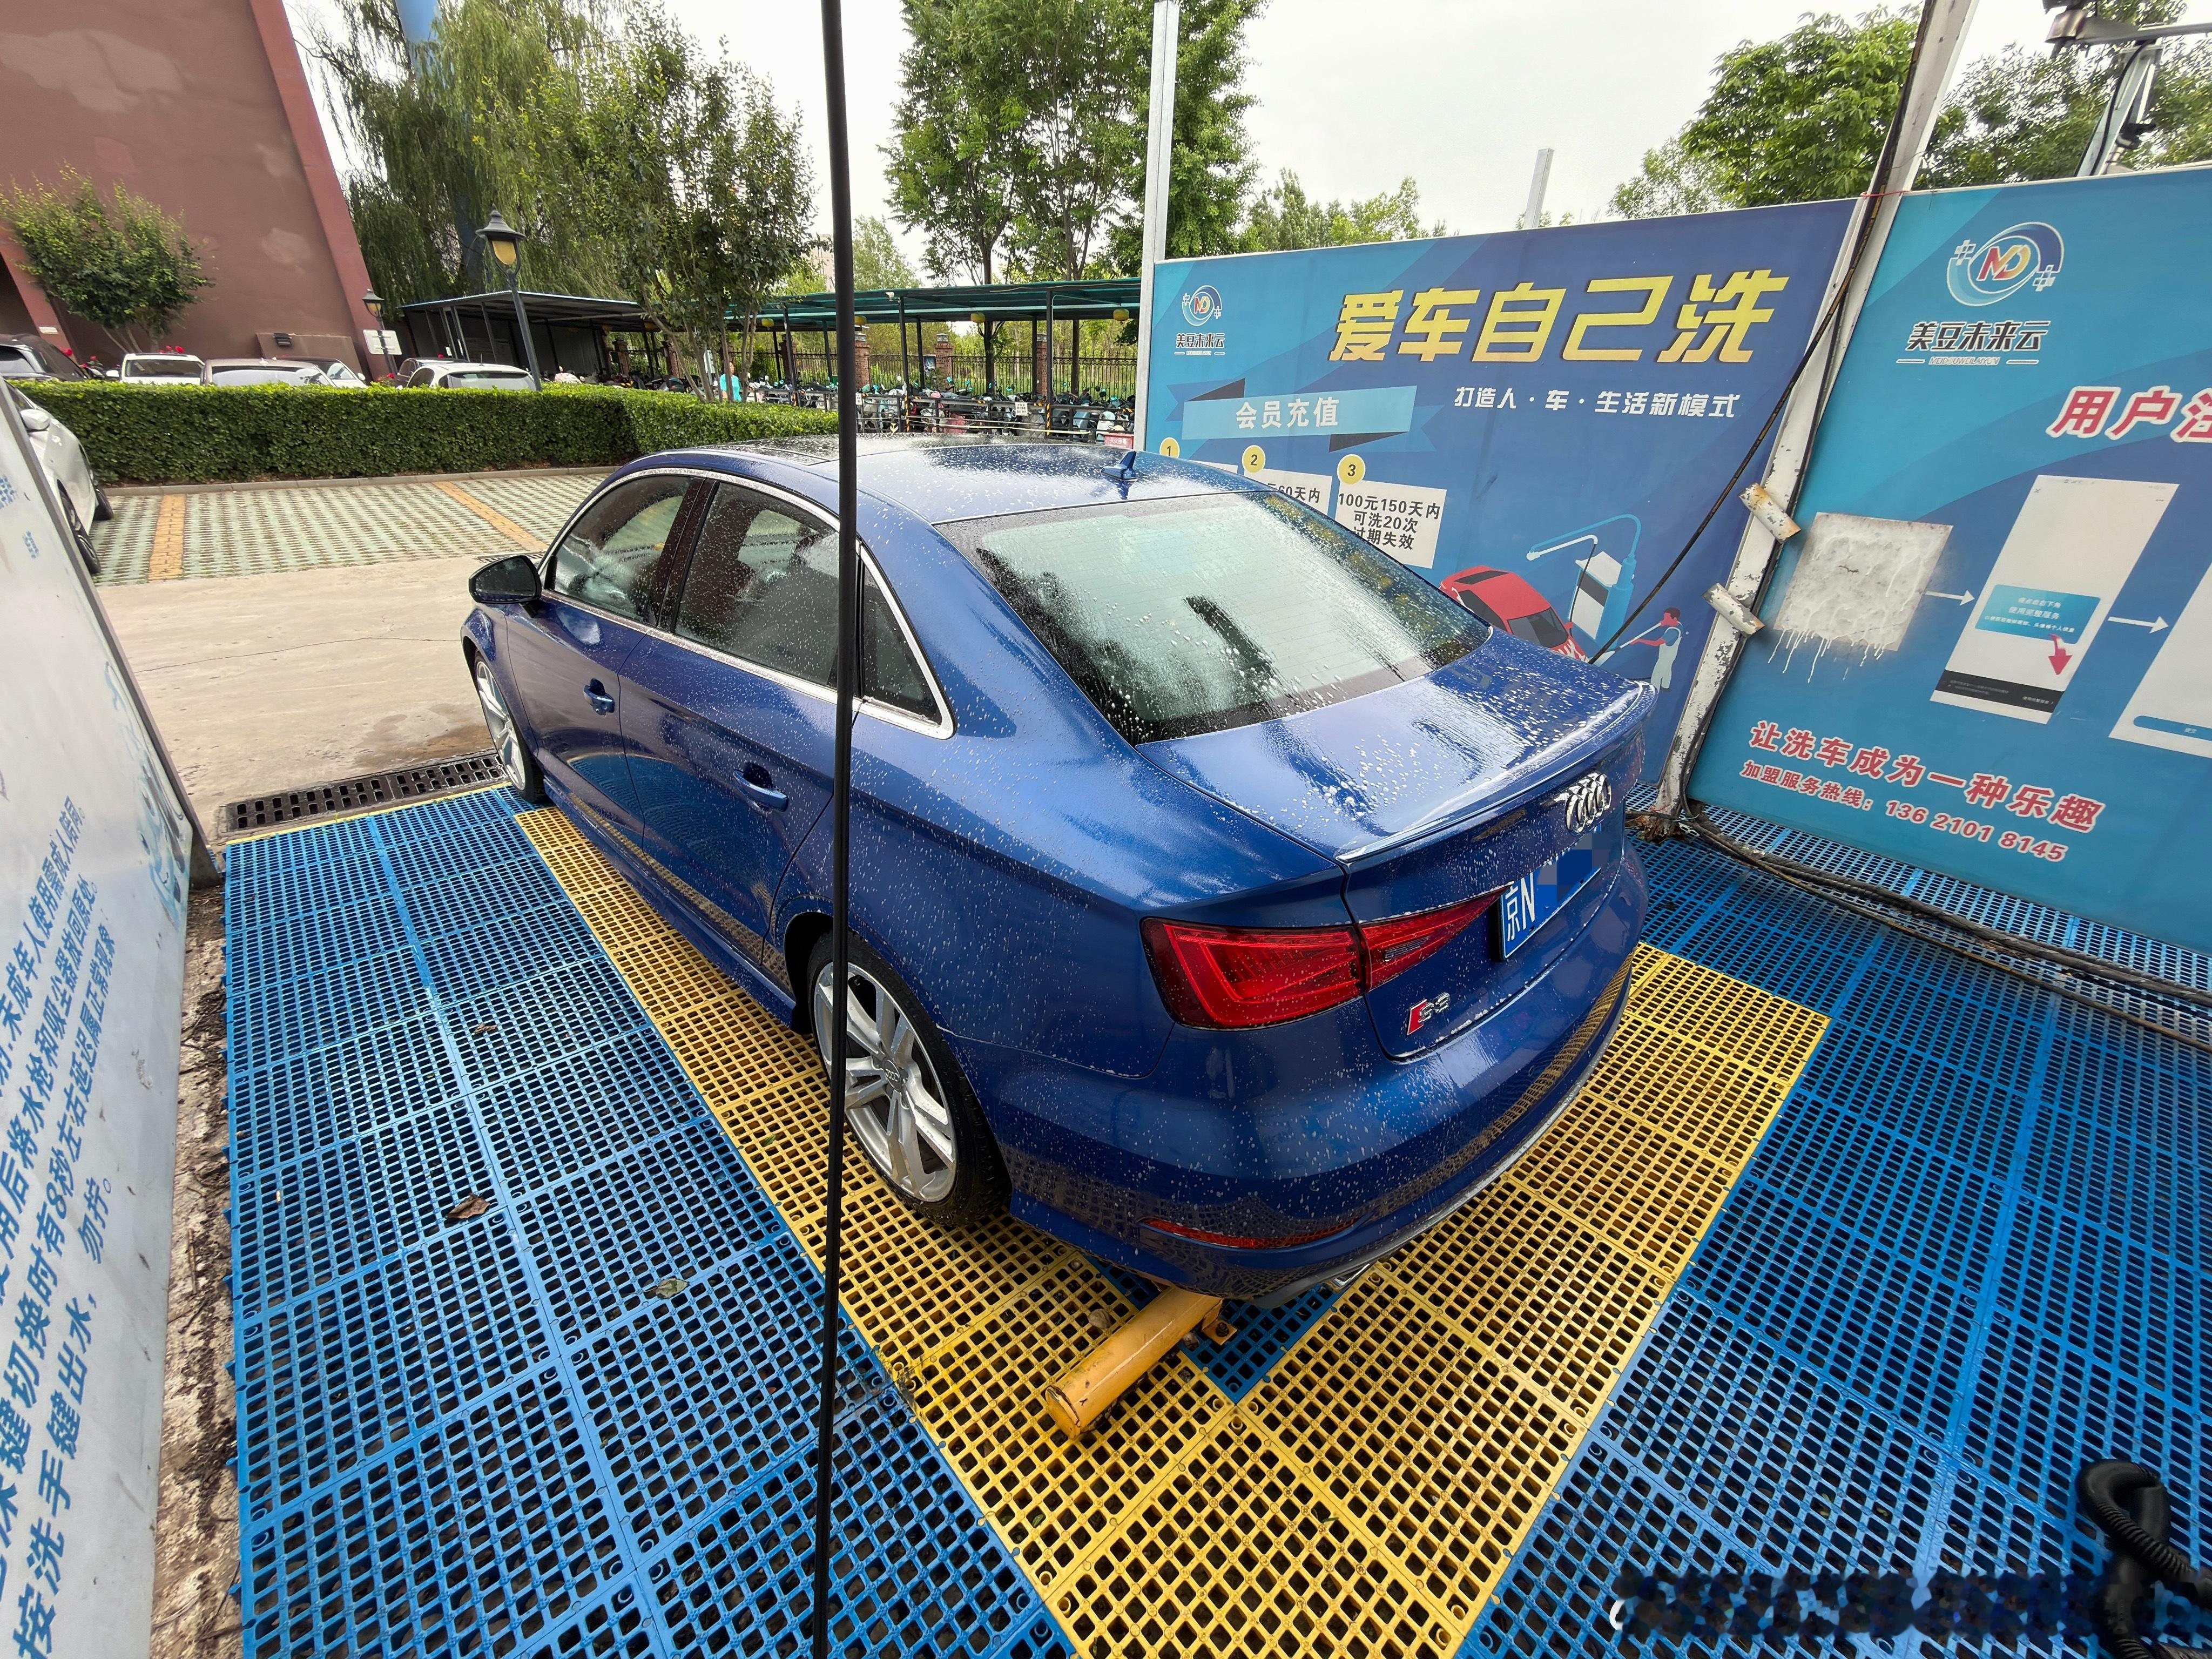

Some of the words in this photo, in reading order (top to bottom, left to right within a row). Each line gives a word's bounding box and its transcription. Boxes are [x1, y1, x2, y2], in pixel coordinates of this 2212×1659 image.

[1328, 269, 1789, 362] 爱车自己洗
[1176, 333, 1225, 348] 美豆未来云
[1905, 320, 2051, 352] 美豆未来云
[1236, 397, 1339, 429] 会员充值
[1167, 446, 1171, 456] 1
[1250, 454, 1258, 466] 2
[1347, 464, 1356, 476] 3
[1267, 483, 1320, 503] 60天内
[1339, 493, 1440, 520] 100元150天内
[1354, 510, 1418, 534] 可洗20次
[1751, 721, 2105, 832] 让洗车成为一种乐趣
[1886, 800, 1928, 823] 136
[1930, 813, 1994, 842] 2101
[1999, 831, 2069, 861] 8145
[1505, 872, 1535, 941] 京N
[0, 873, 97, 1305] 用后将水枪和吸尘器放回原处。
[0, 923, 115, 1602] 沫键切换时有8秒左右延迟属正常现象
